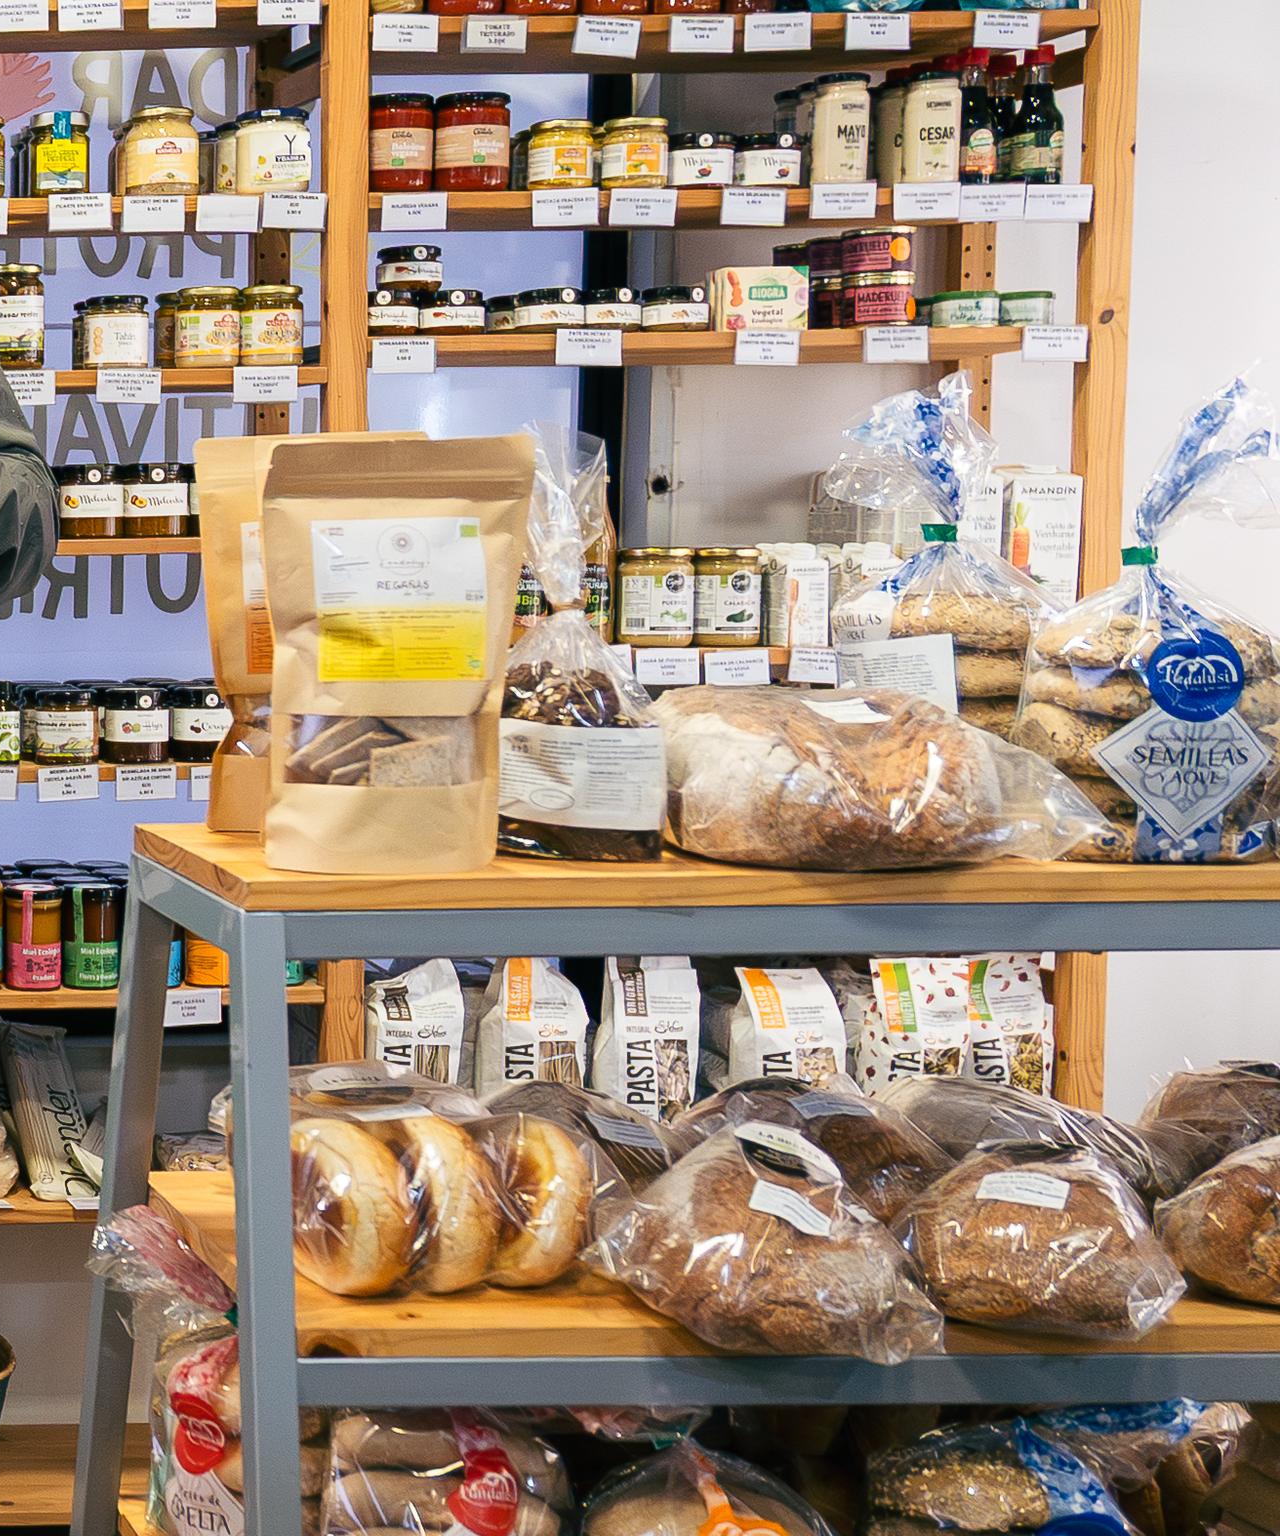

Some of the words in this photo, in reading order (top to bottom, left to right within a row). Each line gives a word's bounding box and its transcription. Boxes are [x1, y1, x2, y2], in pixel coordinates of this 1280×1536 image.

[838, 125, 866, 138] MAYO
[920, 127, 956, 141] CESAR
[385, 1030, 413, 1039] INTEGRAL
[383, 1044, 412, 1066] TA
[505, 1043, 534, 1080] STA
[762, 1051, 793, 1077] TA
[626, 1039, 656, 1105] PASTA
